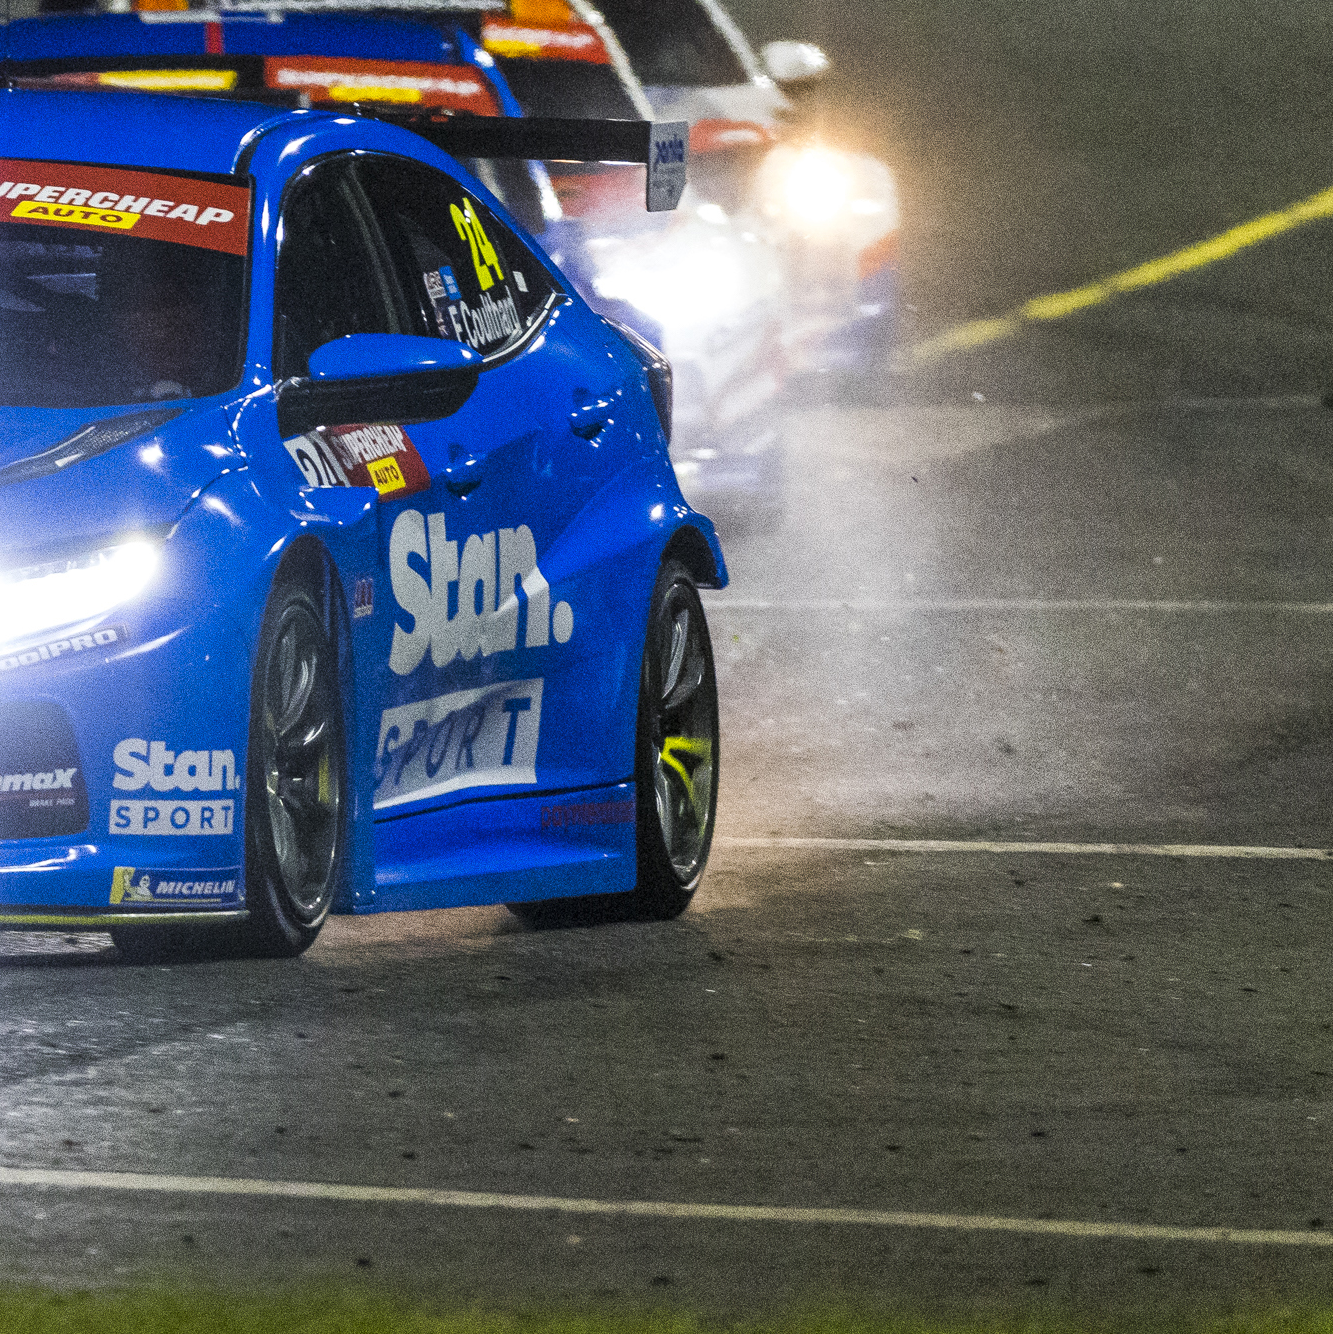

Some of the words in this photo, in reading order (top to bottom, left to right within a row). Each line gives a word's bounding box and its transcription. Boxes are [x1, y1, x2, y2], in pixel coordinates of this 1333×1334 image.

[26, 205, 124, 223] AUTO
[449, 197, 504, 291] 24
[373, 466, 400, 486] AUTO
[114, 805, 233, 828] SPORT
[156, 878, 236, 896] MICHELIN
